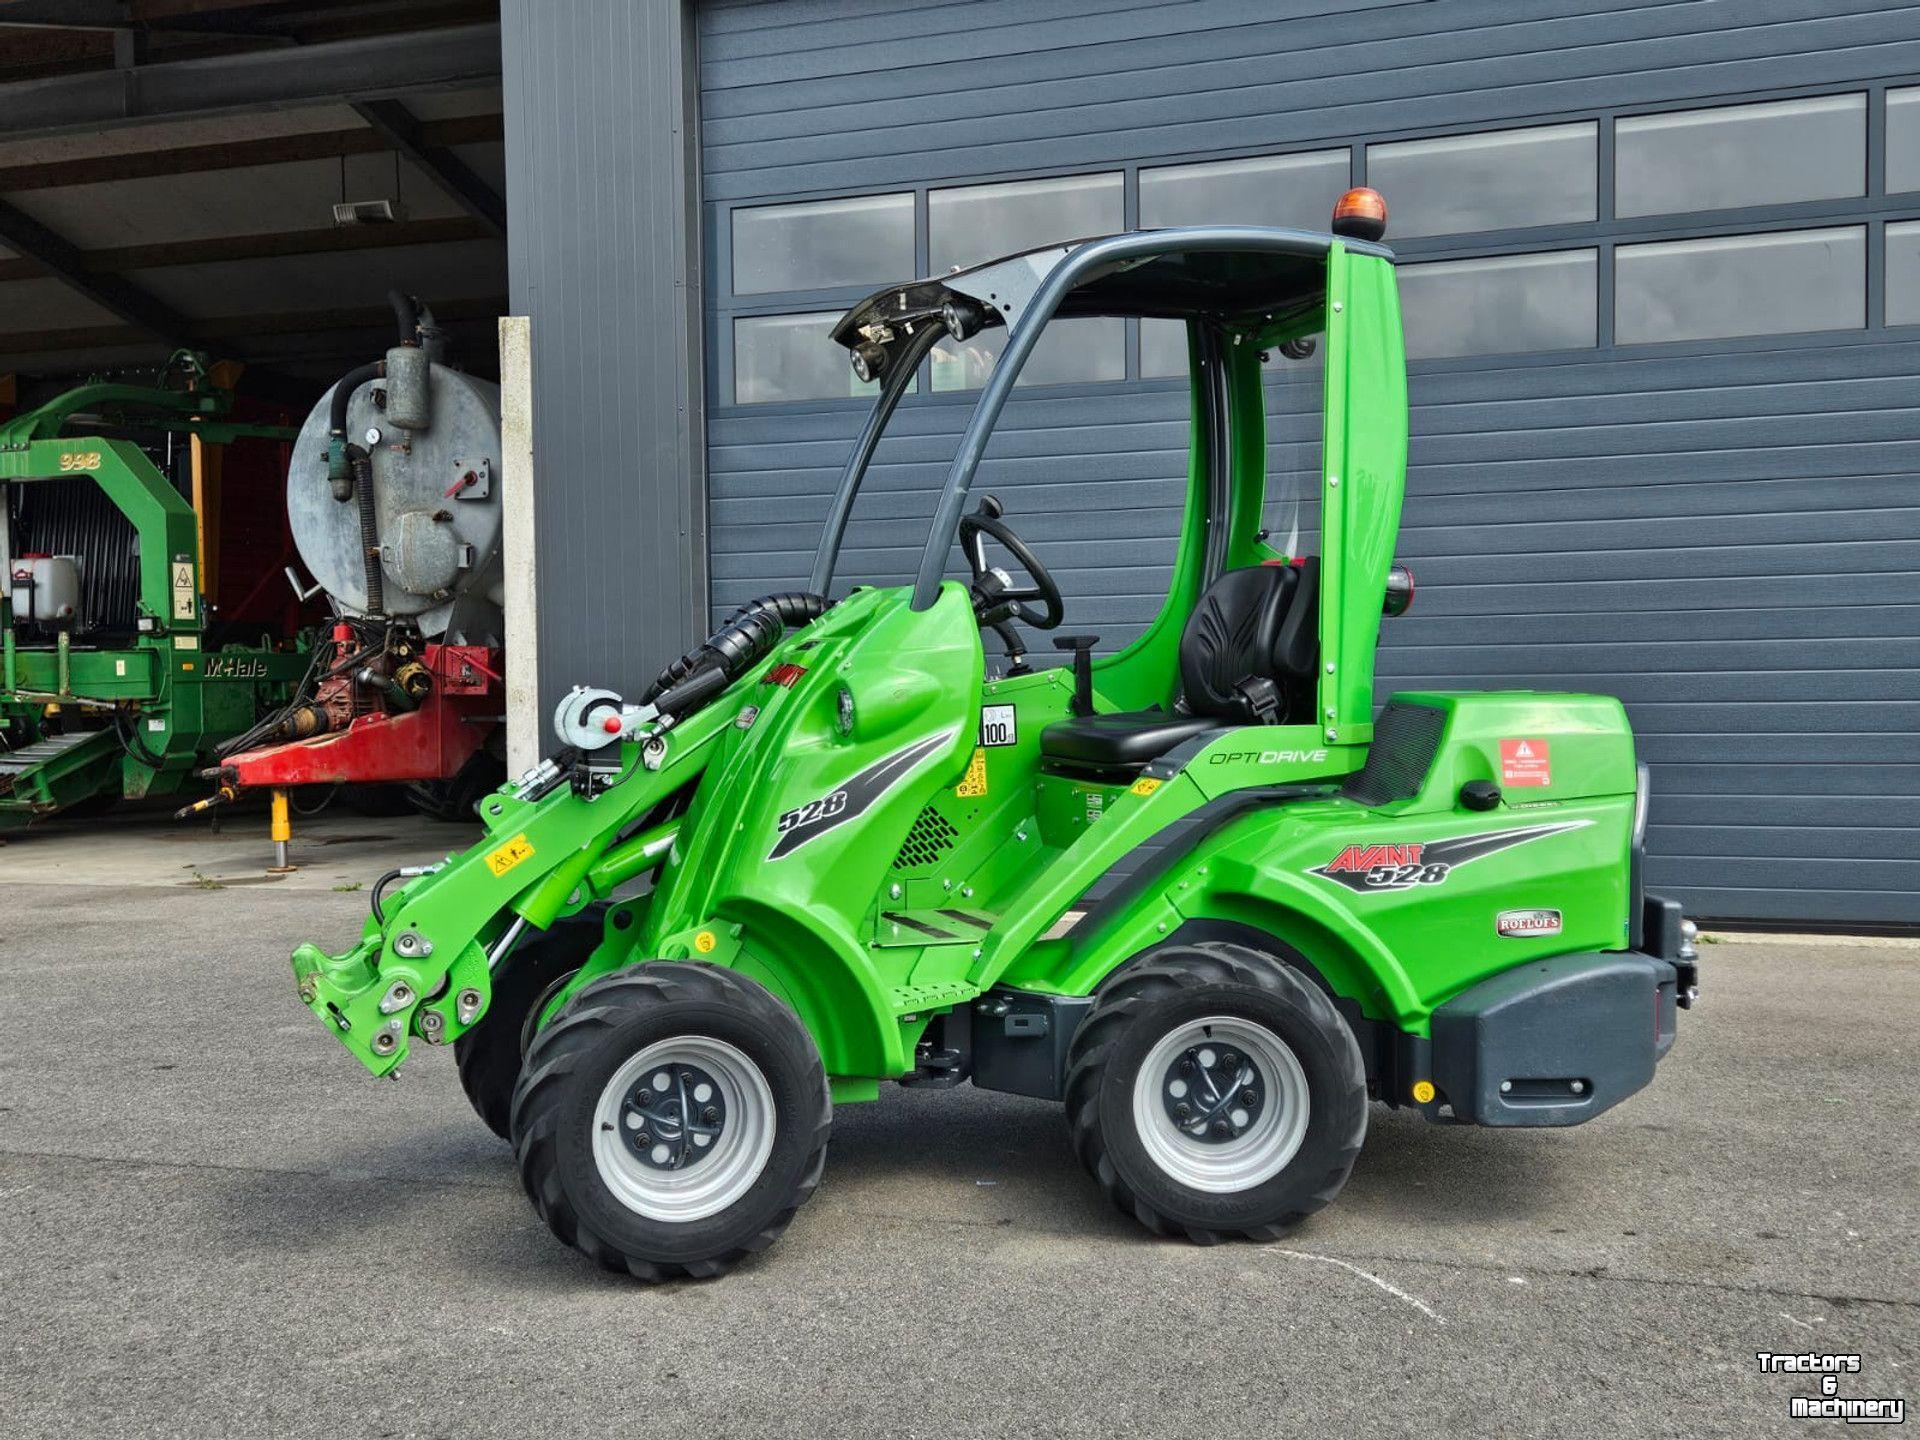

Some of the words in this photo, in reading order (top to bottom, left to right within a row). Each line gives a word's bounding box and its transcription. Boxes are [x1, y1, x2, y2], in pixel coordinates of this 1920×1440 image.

[985, 722, 1007, 744] 100
[1209, 749, 1329, 765] OPTIDRIVE
[777, 790, 848, 833] 528
[1323, 843, 1425, 873] AVANT
[1365, 863, 1450, 886] 528
